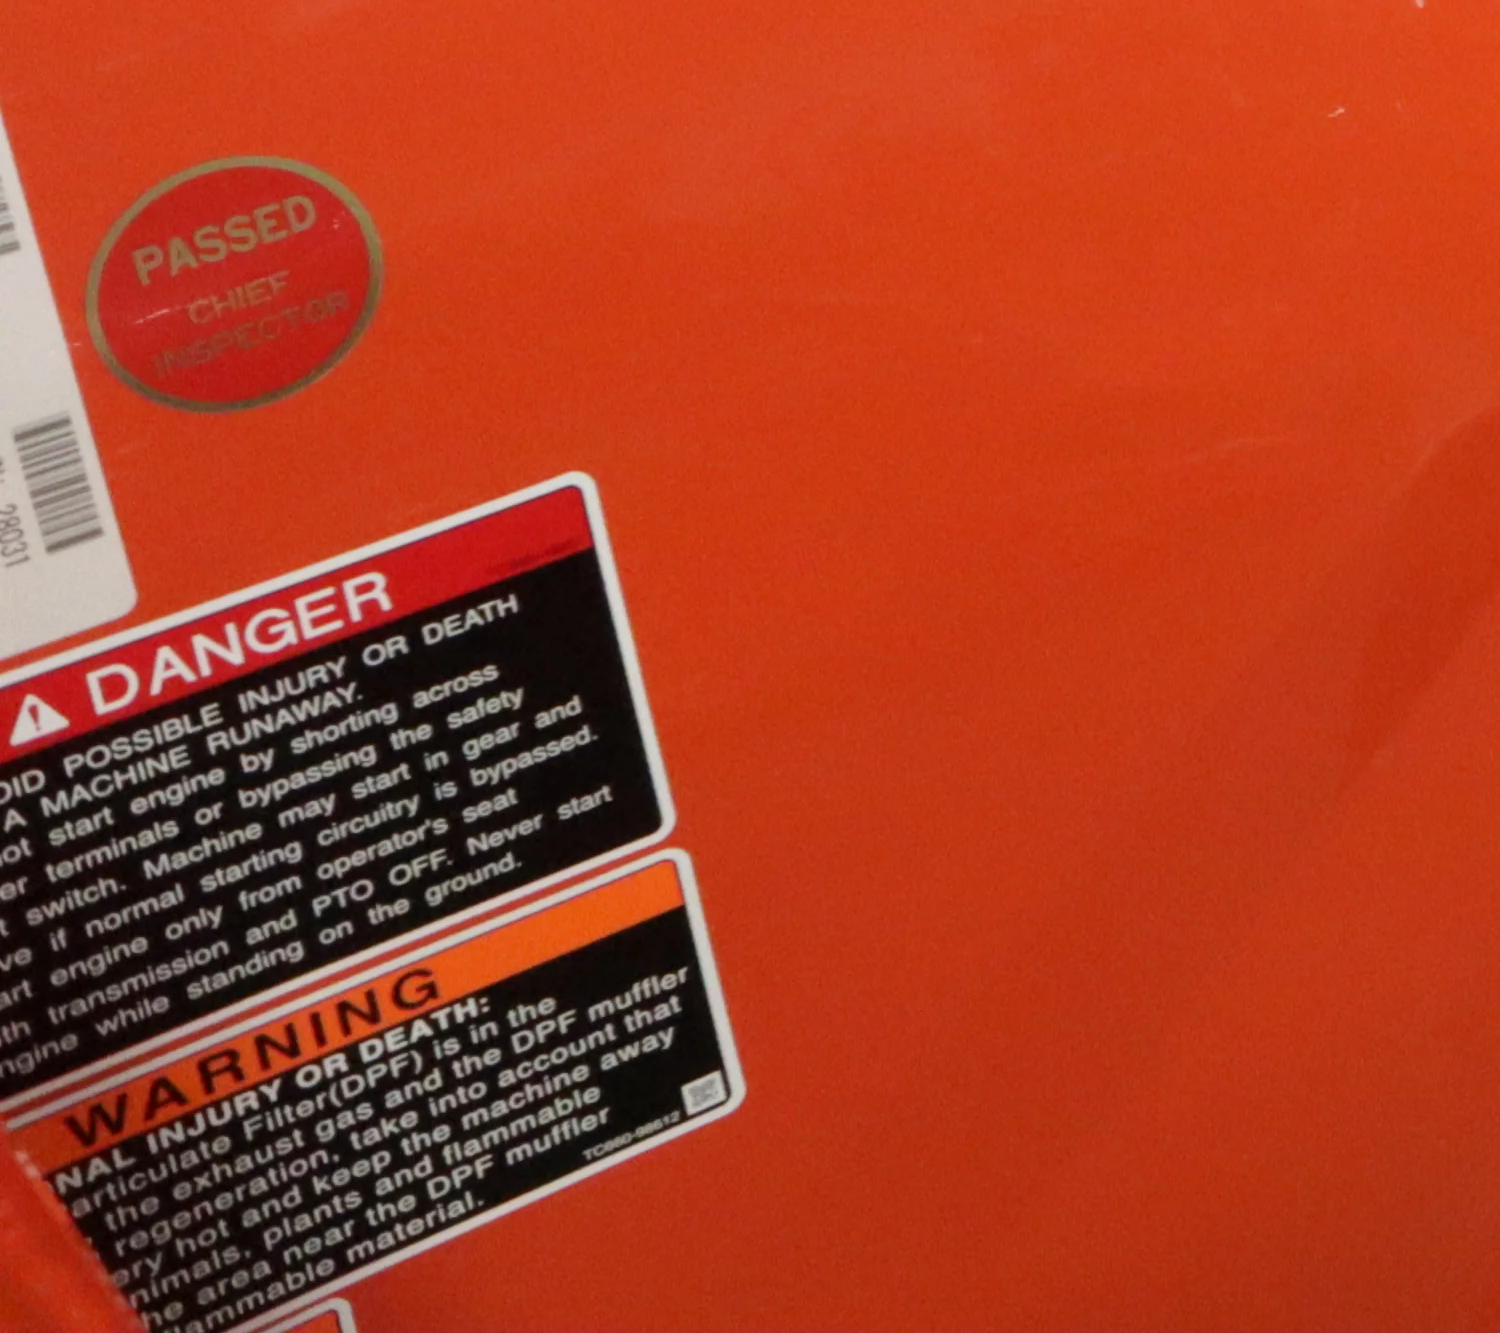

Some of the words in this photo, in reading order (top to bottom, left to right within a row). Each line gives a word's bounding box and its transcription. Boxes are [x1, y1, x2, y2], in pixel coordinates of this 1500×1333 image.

[131, 195, 316, 286] PASSED
[187, 270, 290, 325] CHIEF
[155, 291, 348, 380] INSPECTOR
[63, 702, 224, 778] POSSIBLE
[237, 655, 347, 713] INJURY
[362, 635, 410, 667] OR
[421, 593, 519, 646] DEATH
[86, 572, 393, 716] DANGER
[3, 808, 28, 834] A
[40, 744, 192, 818] MACHINE
[206, 681, 364, 756] RUNAWAY.
[26, 878, 127, 926] switch.
[142, 823, 263, 880] Machine
[278, 793, 336, 828] may
[351, 762, 412, 800] start
[423, 751, 450, 772] in
[462, 721, 521, 761] gear
[534, 695, 582, 729] and
[44, 820, 180, 883] terminals
[194, 801, 224, 826] or
[237, 744, 377, 809] bypassing
[389, 724, 433, 750] the
[446, 687, 524, 729] safety
[48, 806, 115, 846] start
[130, 768, 226, 815] engine
[239, 748, 275, 773] by
[290, 702, 399, 754] shorting
[412, 665, 500, 709] across
[49, 927, 67, 952] if
[84, 882, 185, 938] normal
[199, 841, 303, 893] starting
[317, 794, 420, 846] circuitry
[433, 781, 458, 801] is
[469, 724, 599, 787] bypassed.
[47, 940, 230, 1025] transmission
[246, 908, 298, 946] and
[312, 879, 375, 918] PTO
[388, 848, 454, 886] OFF.
[466, 813, 543, 856] Never
[557, 785, 613, 820] start
[50, 937, 148, 986] engine
[165, 905, 223, 940] only
[238, 875, 303, 911] from
[316, 818, 449, 880] operator's
[461, 787, 519, 823] seat
[94, 996, 170, 1036] while
[186, 940, 305, 1000] standing
[318, 920, 354, 945] on
[367, 898, 410, 925] the
[424, 851, 523, 907] ground.
[64, 967, 440, 1147] WARNING
[104, 1196, 159, 1232] the
[172, 1128, 305, 1201] exhaust
[315, 1102, 374, 1142] gas
[384, 1067, 443, 1109] and
[451, 1048, 502, 1079] the
[511, 1009, 577, 1054] DPF
[587, 966, 688, 1023] muffler
[114, 1150, 342, 1258] regeneration,
[349, 1111, 418, 1151] take
[428, 1081, 488, 1117] into
[498, 1023, 617, 1088] account
[623, 995, 682, 1033] that
[146, 1078, 281, 1155] INJURY
[295, 1053, 349, 1089] OR
[359, 997, 491, 1063] DEATH:
[175, 1219, 230, 1258] hot
[242, 1184, 303, 1228] and
[312, 1150, 392, 1195] keep
[400, 1124, 451, 1156] the
[461, 1064, 590, 1131] machine
[600, 1026, 675, 1071] away
[242, 1050, 423, 1142] Filter(DPF)
[432, 1037, 461, 1060] is
[468, 1021, 499, 1044] in
[506, 997, 556, 1028] the
[197, 1260, 272, 1305] area
[282, 1219, 355, 1265] near
[365, 1194, 416, 1227] the
[426, 1154, 494, 1200] DPF
[505, 1107, 610, 1166] muffler
[263, 1191, 363, 1251] plants
[375, 1154, 433, 1196] and
[442, 1087, 601, 1165] flammable
[346, 1190, 485, 1264] material.
